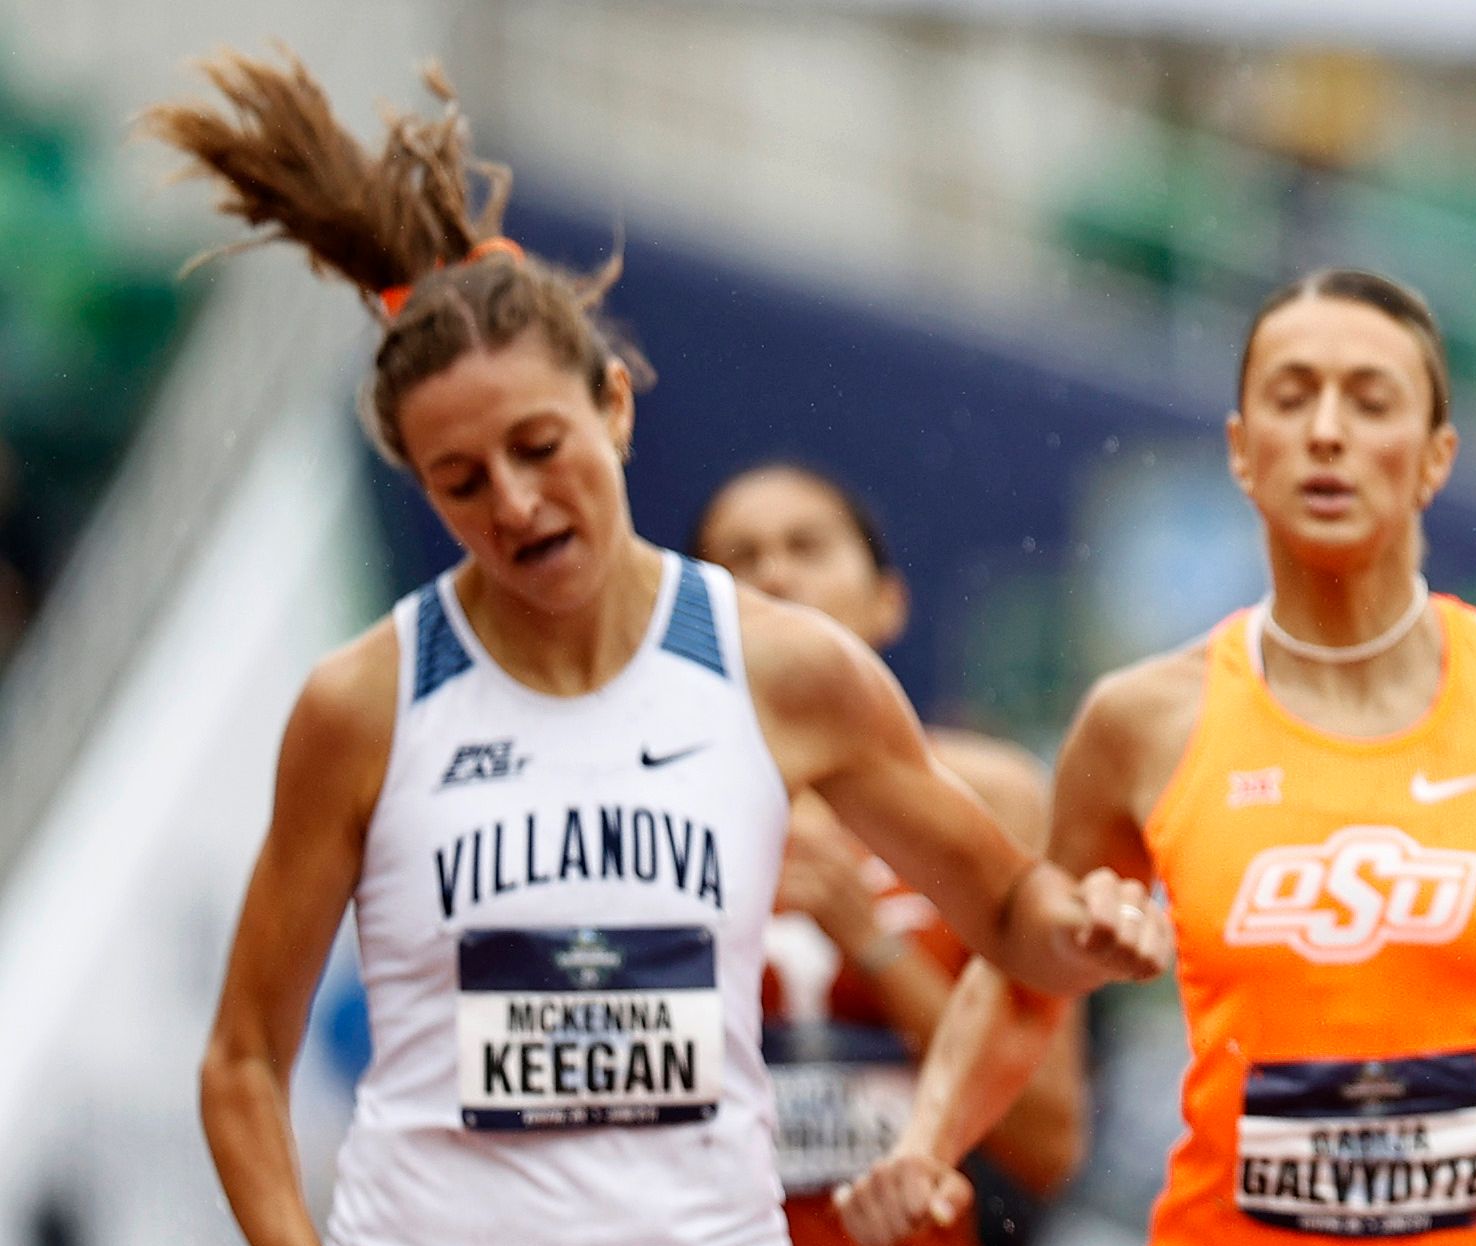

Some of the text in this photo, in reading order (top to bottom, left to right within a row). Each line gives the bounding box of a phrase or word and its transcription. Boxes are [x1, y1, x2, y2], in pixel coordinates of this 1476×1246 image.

[434, 804, 725, 919] VILLANOVA
[507, 1000, 672, 1032] MCKENNA
[483, 1040, 695, 1095] KEEGAN
